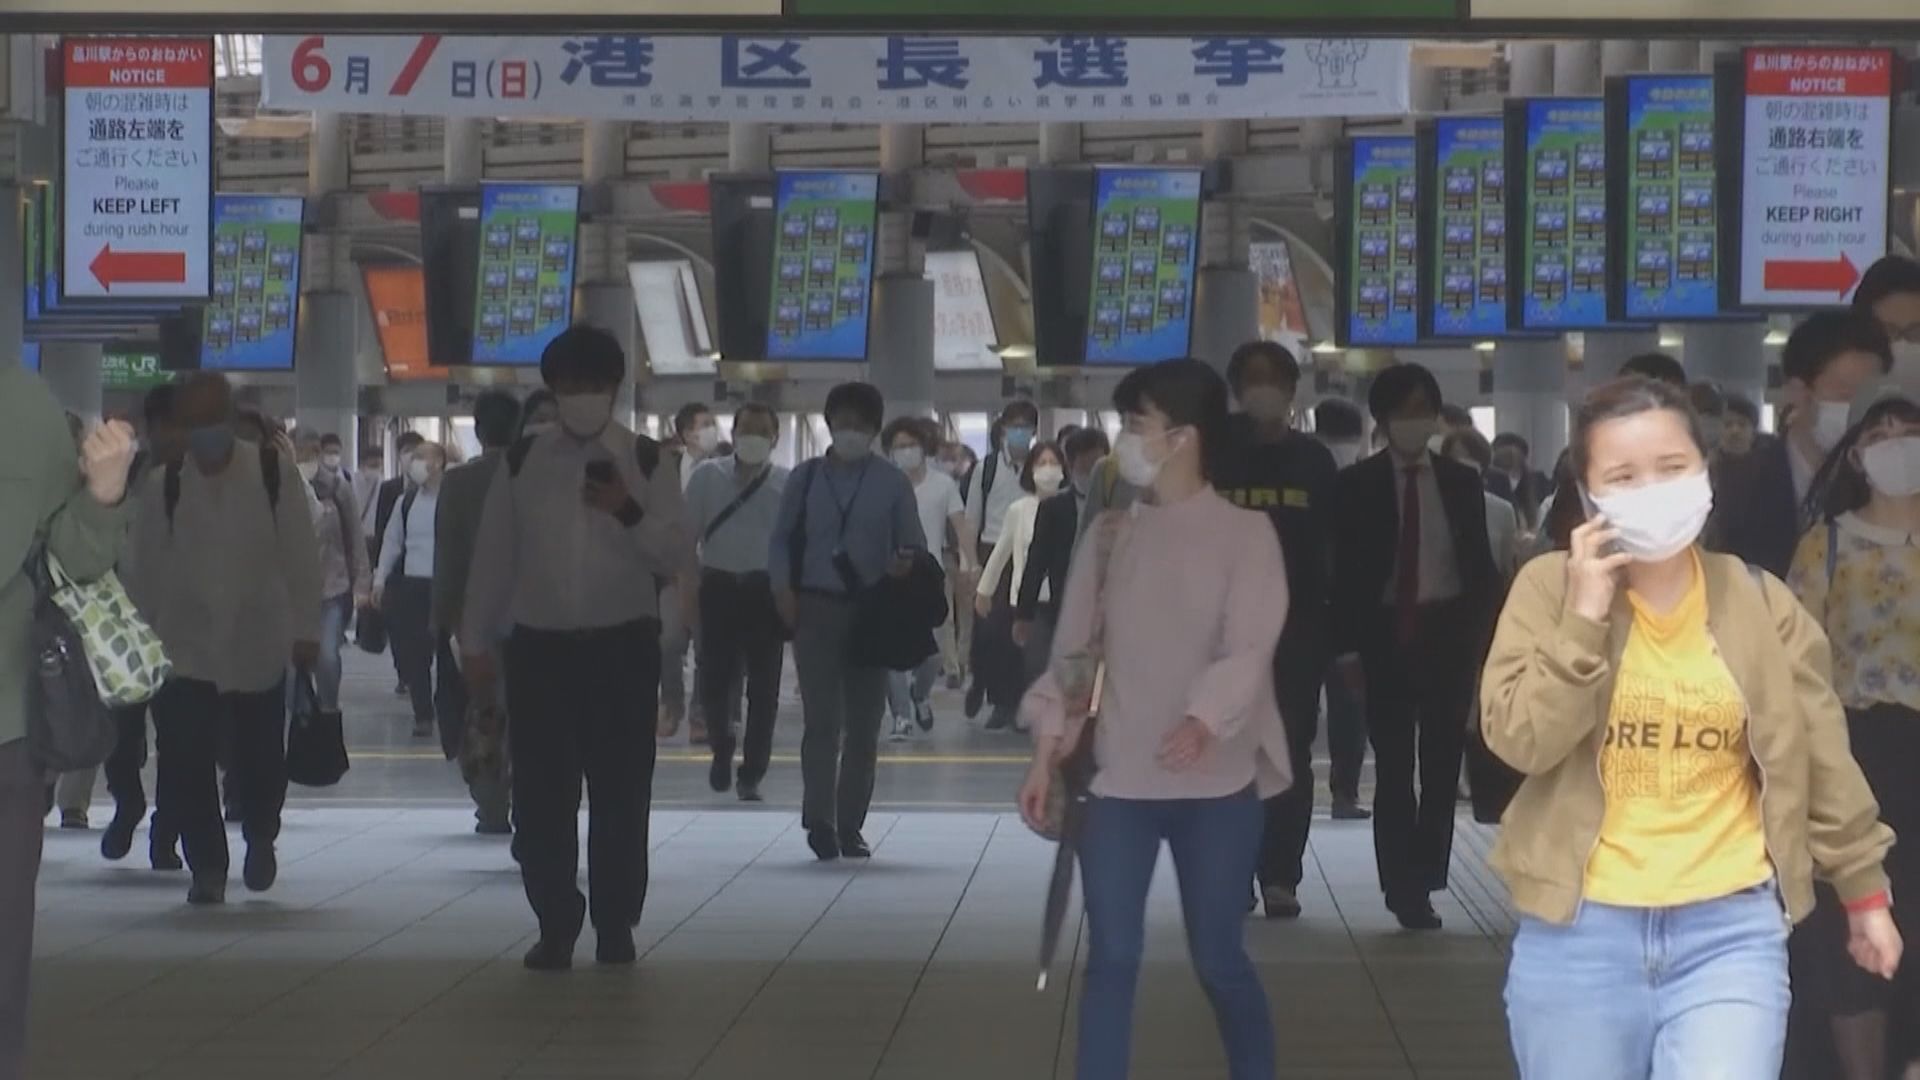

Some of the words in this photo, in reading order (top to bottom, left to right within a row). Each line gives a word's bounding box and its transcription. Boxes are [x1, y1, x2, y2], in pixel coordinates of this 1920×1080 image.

[72, 46, 203, 63] 品川駅からのおねがい
[1753, 54, 1884, 71] 品川駅からのおねがい
[109, 68, 166, 83] NOTICE
[1790, 77, 1846, 93] NOTICE
[85, 92, 189, 112] 朝の混雑時は
[1765, 101, 1869, 121] 朝の混雑時は
[88, 117, 185, 141] 通路左端を
[1768, 126, 1864, 149] 通路右端を
[76, 147, 198, 168] ご通行ください
[1756, 156, 1877, 176] ご通行ください
[114, 175, 159, 191] Please
[1793, 183, 1838, 199] Please
[93, 197, 136, 214] KEEP
[140, 197, 181, 214] LEFT
[1766, 206, 1809, 223] KEEP
[1814, 206, 1863, 223] RIGHT
[83, 222, 124, 238] during
[128, 222, 156, 236] rush
[160, 222, 189, 236] hour
[1761, 230, 1801, 247] during
[1805, 230, 1834, 244] rush
[1838, 230, 1867, 244] hour
[131, 355, 156, 372] JR
